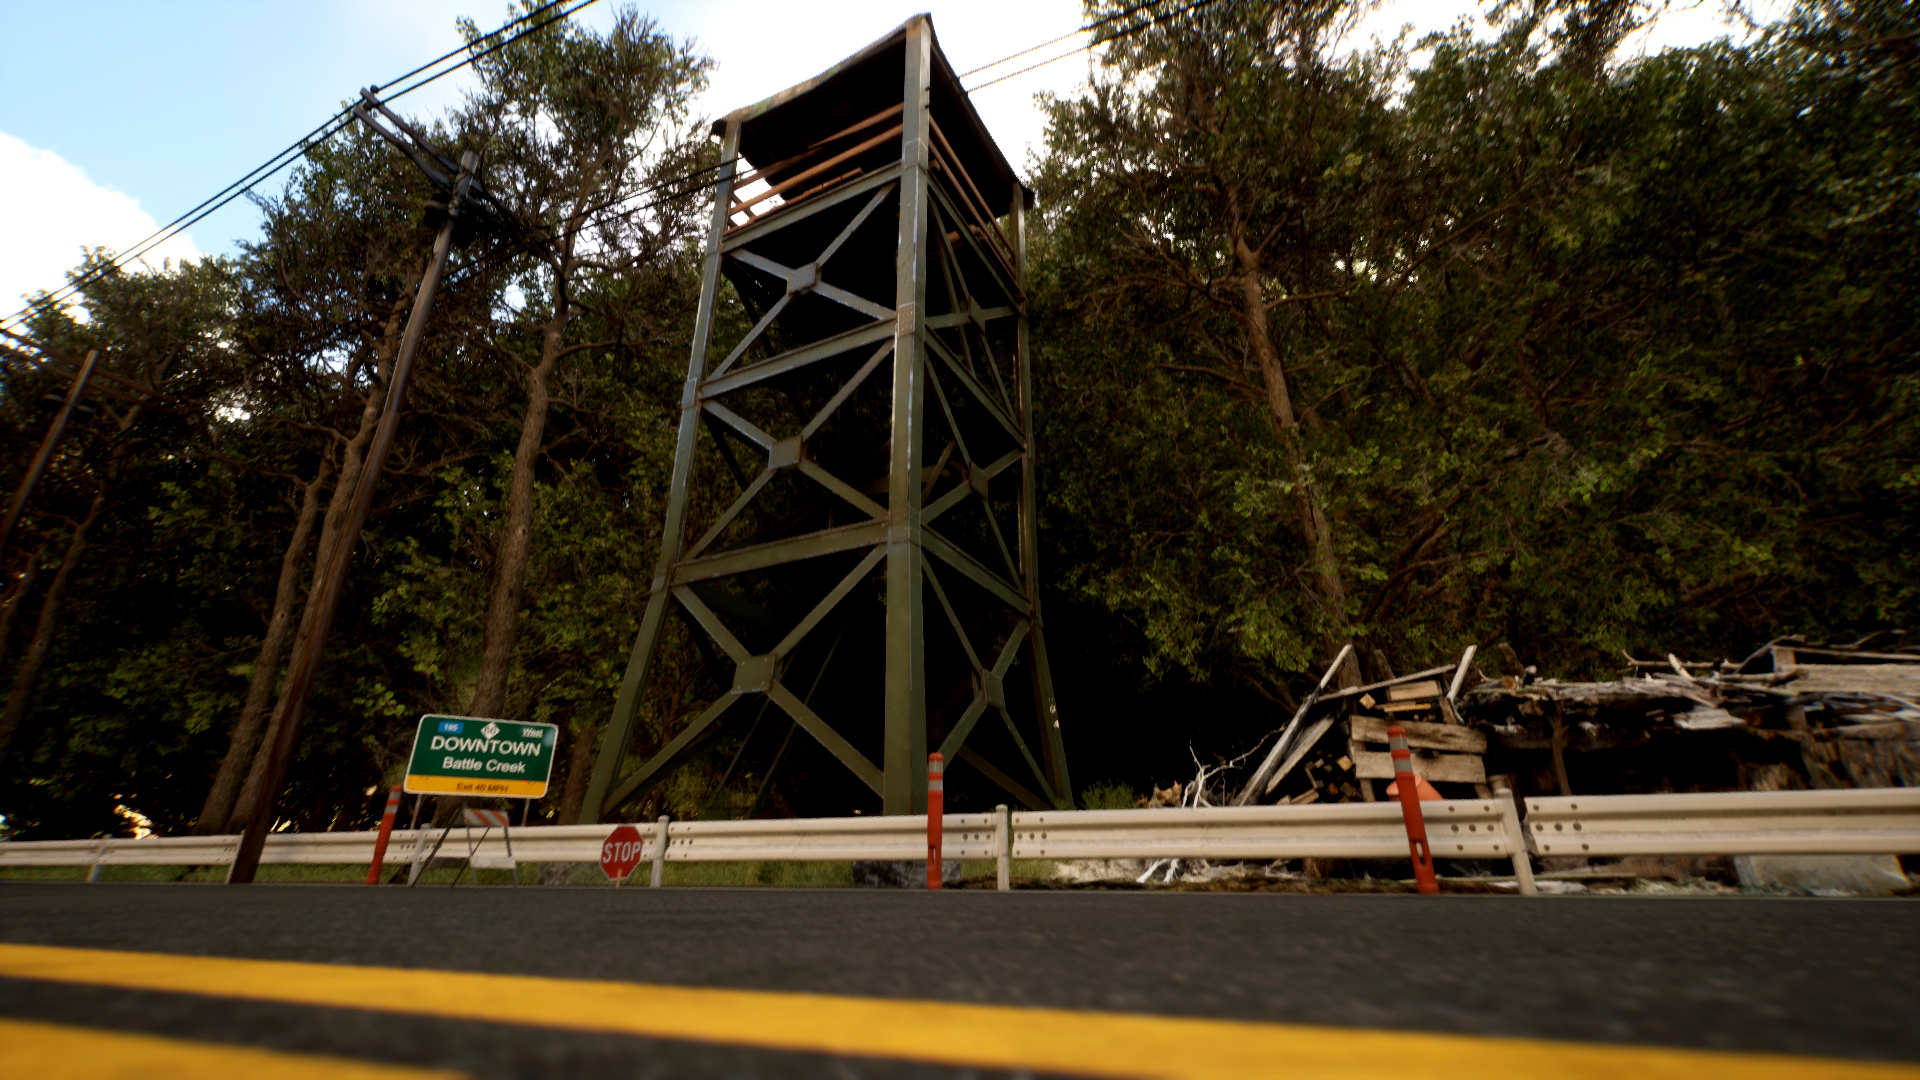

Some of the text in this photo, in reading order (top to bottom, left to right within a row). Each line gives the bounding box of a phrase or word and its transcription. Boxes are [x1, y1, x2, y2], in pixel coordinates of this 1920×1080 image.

[522, 727, 544, 738] West
[430, 735, 541, 756] DOWNTOWN
[442, 756, 526, 773] Battle Creek
[456, 782, 473, 791] Exit
[487, 783, 509, 793] MPH
[602, 841, 641, 864] STOP
